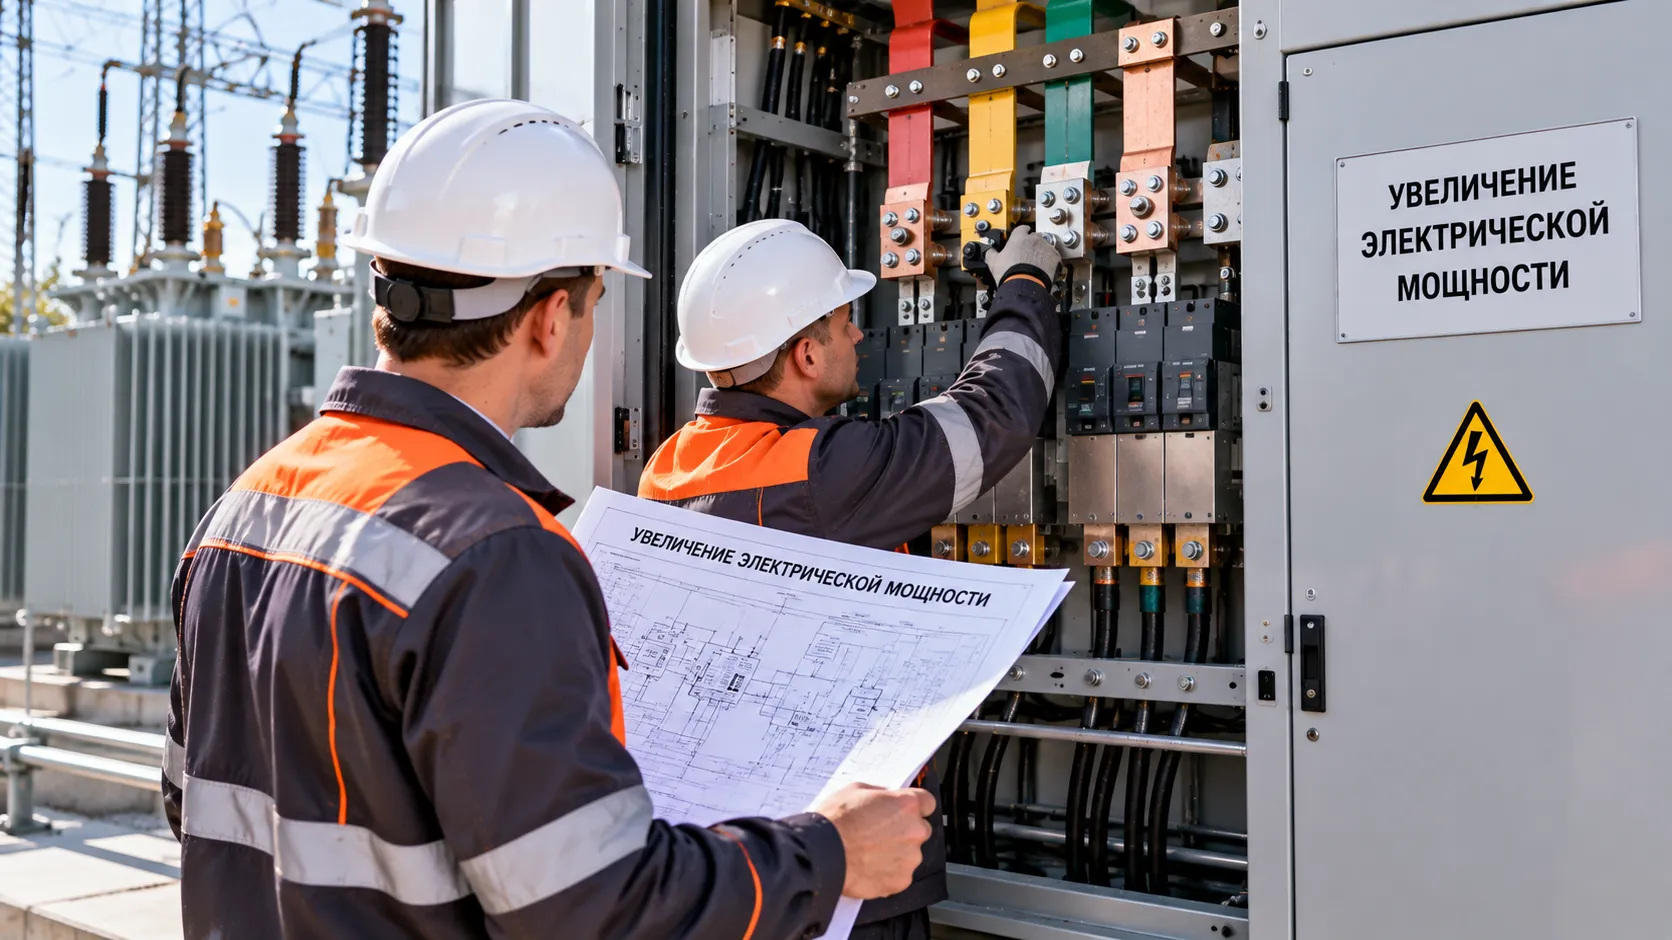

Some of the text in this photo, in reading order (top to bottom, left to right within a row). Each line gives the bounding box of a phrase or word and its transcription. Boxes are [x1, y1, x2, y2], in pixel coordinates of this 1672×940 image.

[1388, 161, 1577, 210] УВЕЛИЧЕНИЕ
[1361, 200, 1609, 258] ЭЛЕКТРИЧЕСКОЙ
[1397, 260, 1569, 301] МОЩНОСТИ
[630, 527, 992, 607] УВЕЛИЧЕНИЕ ЭЛЕКТРИЧЕСКОЙ МОЩНОСТИ
